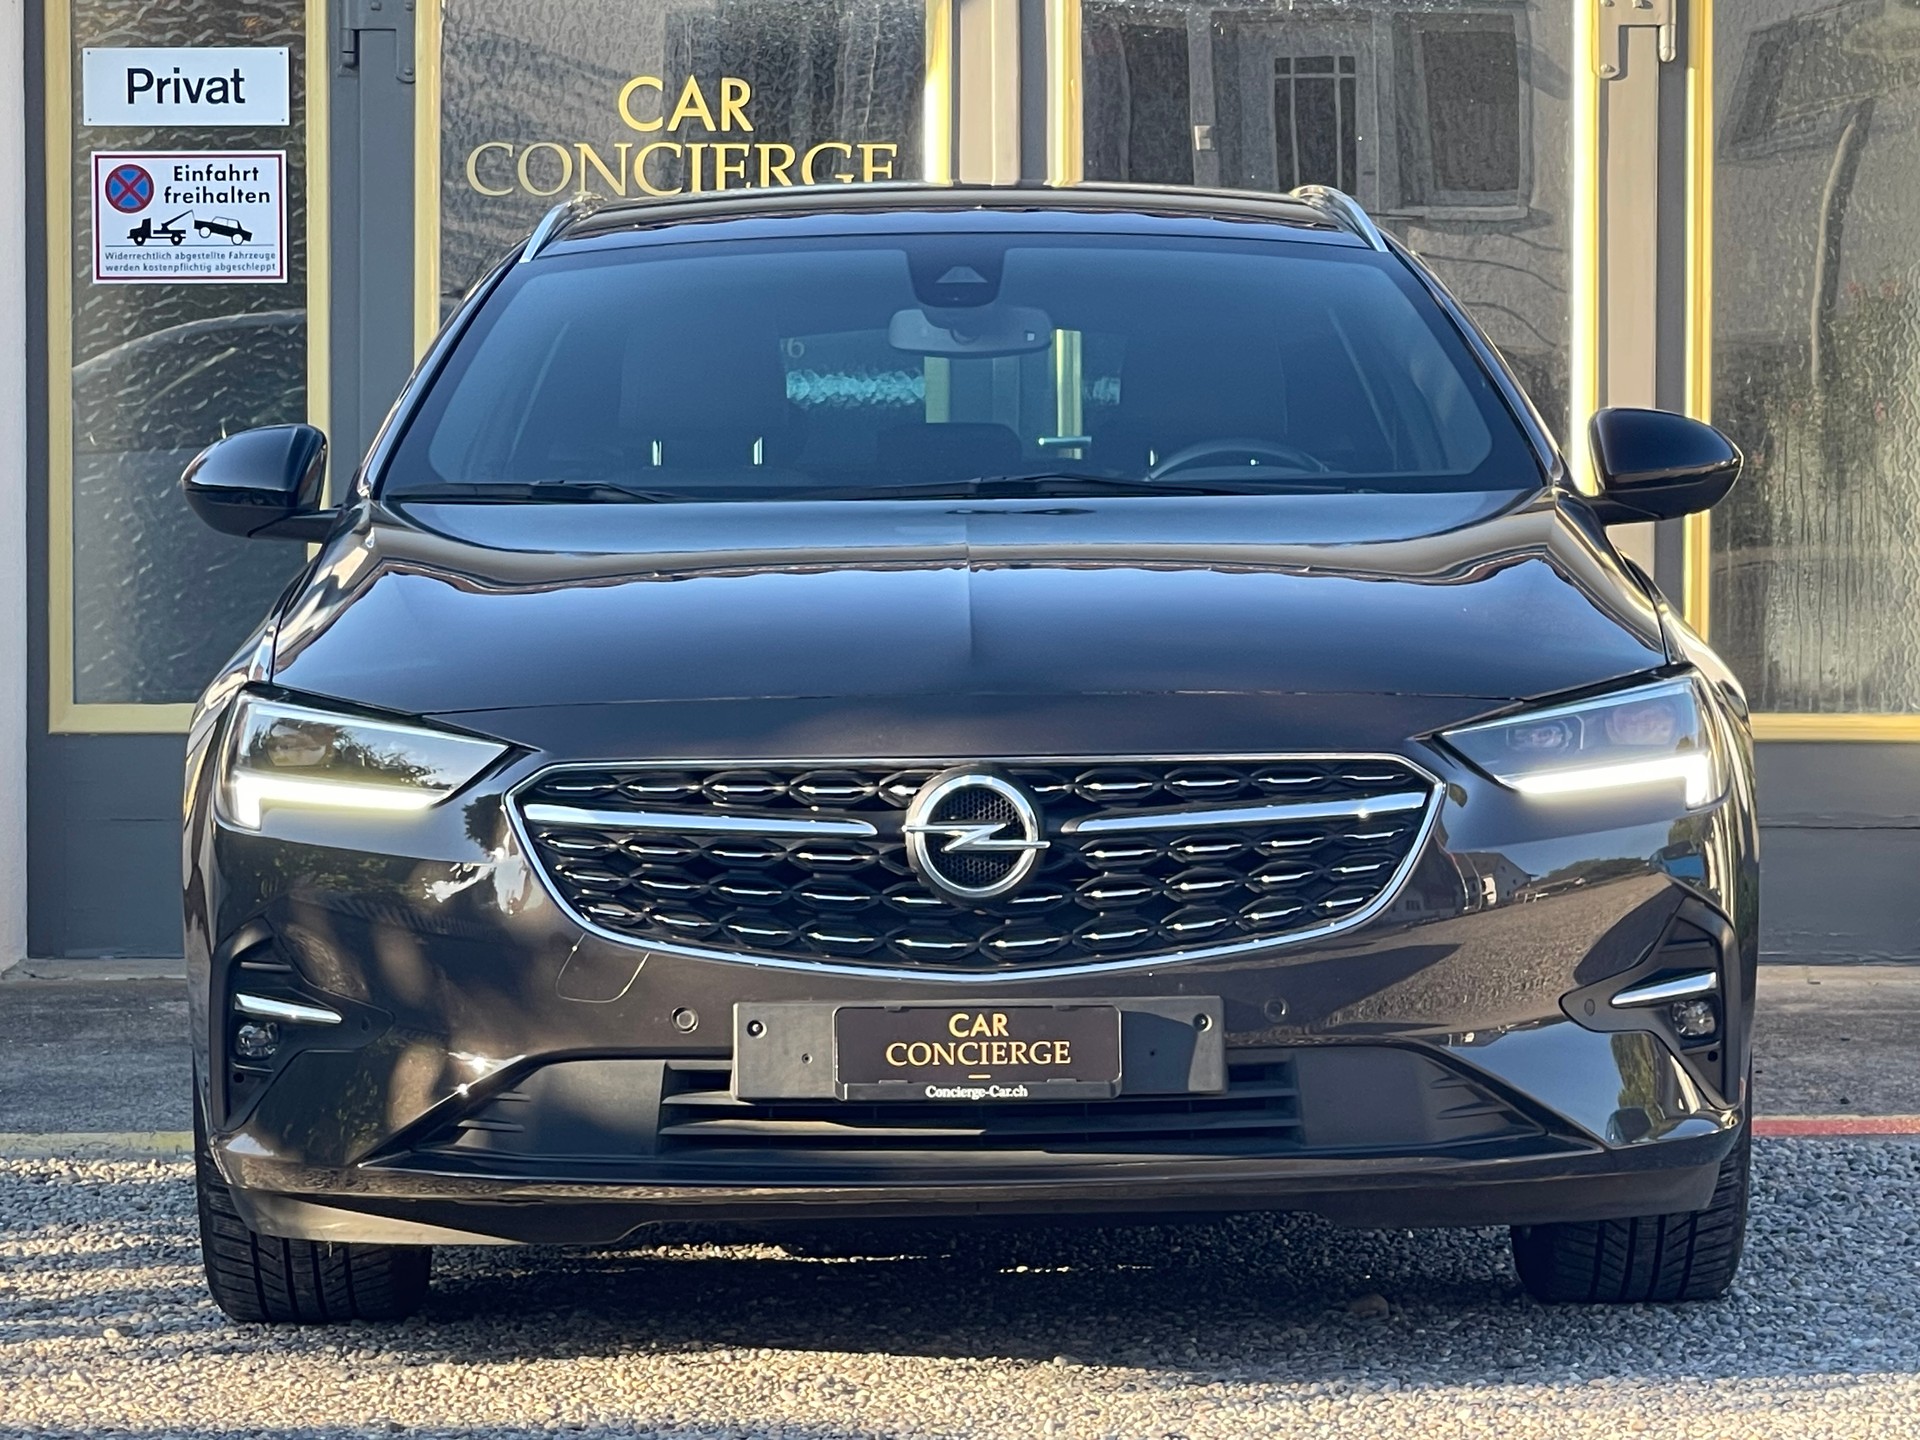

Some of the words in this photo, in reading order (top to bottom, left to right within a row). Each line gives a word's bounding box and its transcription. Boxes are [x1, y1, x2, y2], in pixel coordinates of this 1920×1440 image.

[127, 67, 246, 105] Privat
[618, 75, 754, 132] CAR
[173, 164, 259, 182] Einfahrt
[465, 142, 898, 197] CONCIERGE
[164, 186, 271, 204] freihalten
[105, 251, 172, 260] Widerrechtlich
[174, 251, 226, 262] abgestellte
[228, 251, 276, 262] Fahrzeuge
[105, 263, 140, 272] werden
[143, 262, 212, 273] kostenpflichtig
[215, 262, 276, 273] abgeschleppt
[948, 1013, 1009, 1038] CAR
[885, 1041, 1072, 1067] CONCIERGE
[925, 1084, 1029, 1100] Concierge-Car.ch
